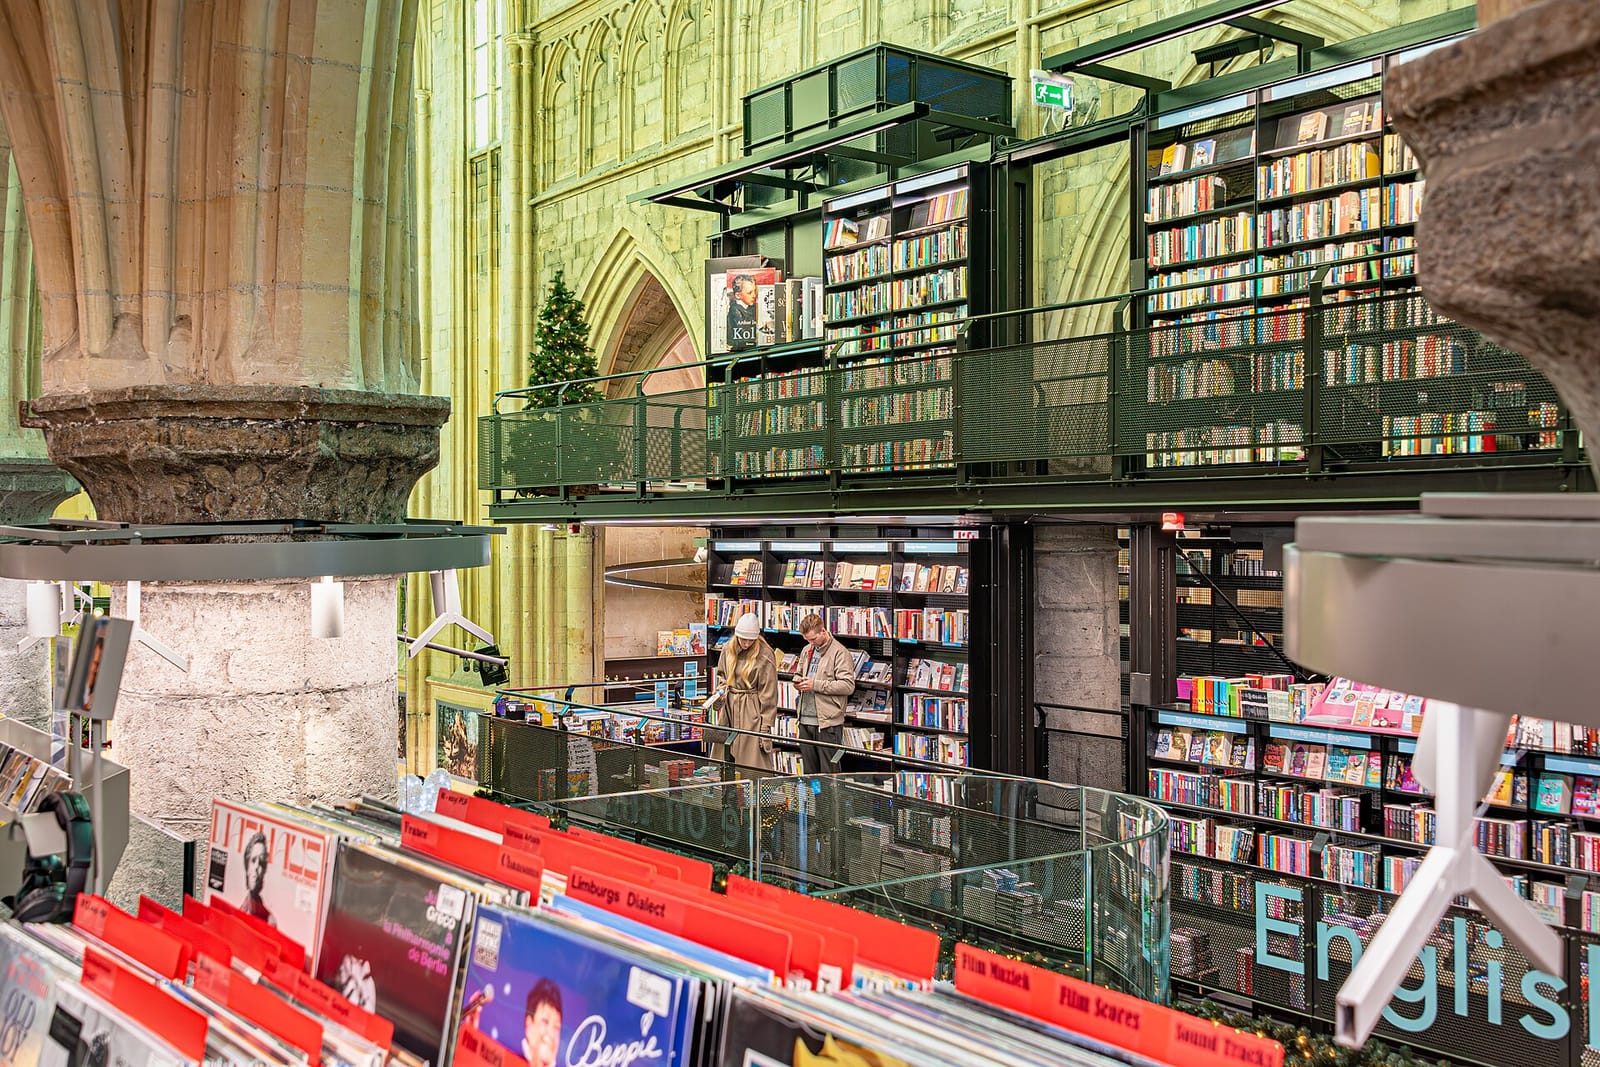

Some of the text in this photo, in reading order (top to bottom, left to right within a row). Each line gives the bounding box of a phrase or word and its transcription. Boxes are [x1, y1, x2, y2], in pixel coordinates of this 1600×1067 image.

[571, 874, 666, 918] Limburgs Dialect
[420, 951, 448, 976] Berlin
[962, 952, 1030, 991] Film Muziek
[1255, 881, 1600, 1050] Englis
[1059, 985, 1141, 1030] Film Scores
[1175, 1022, 1217, 1052] Sound
